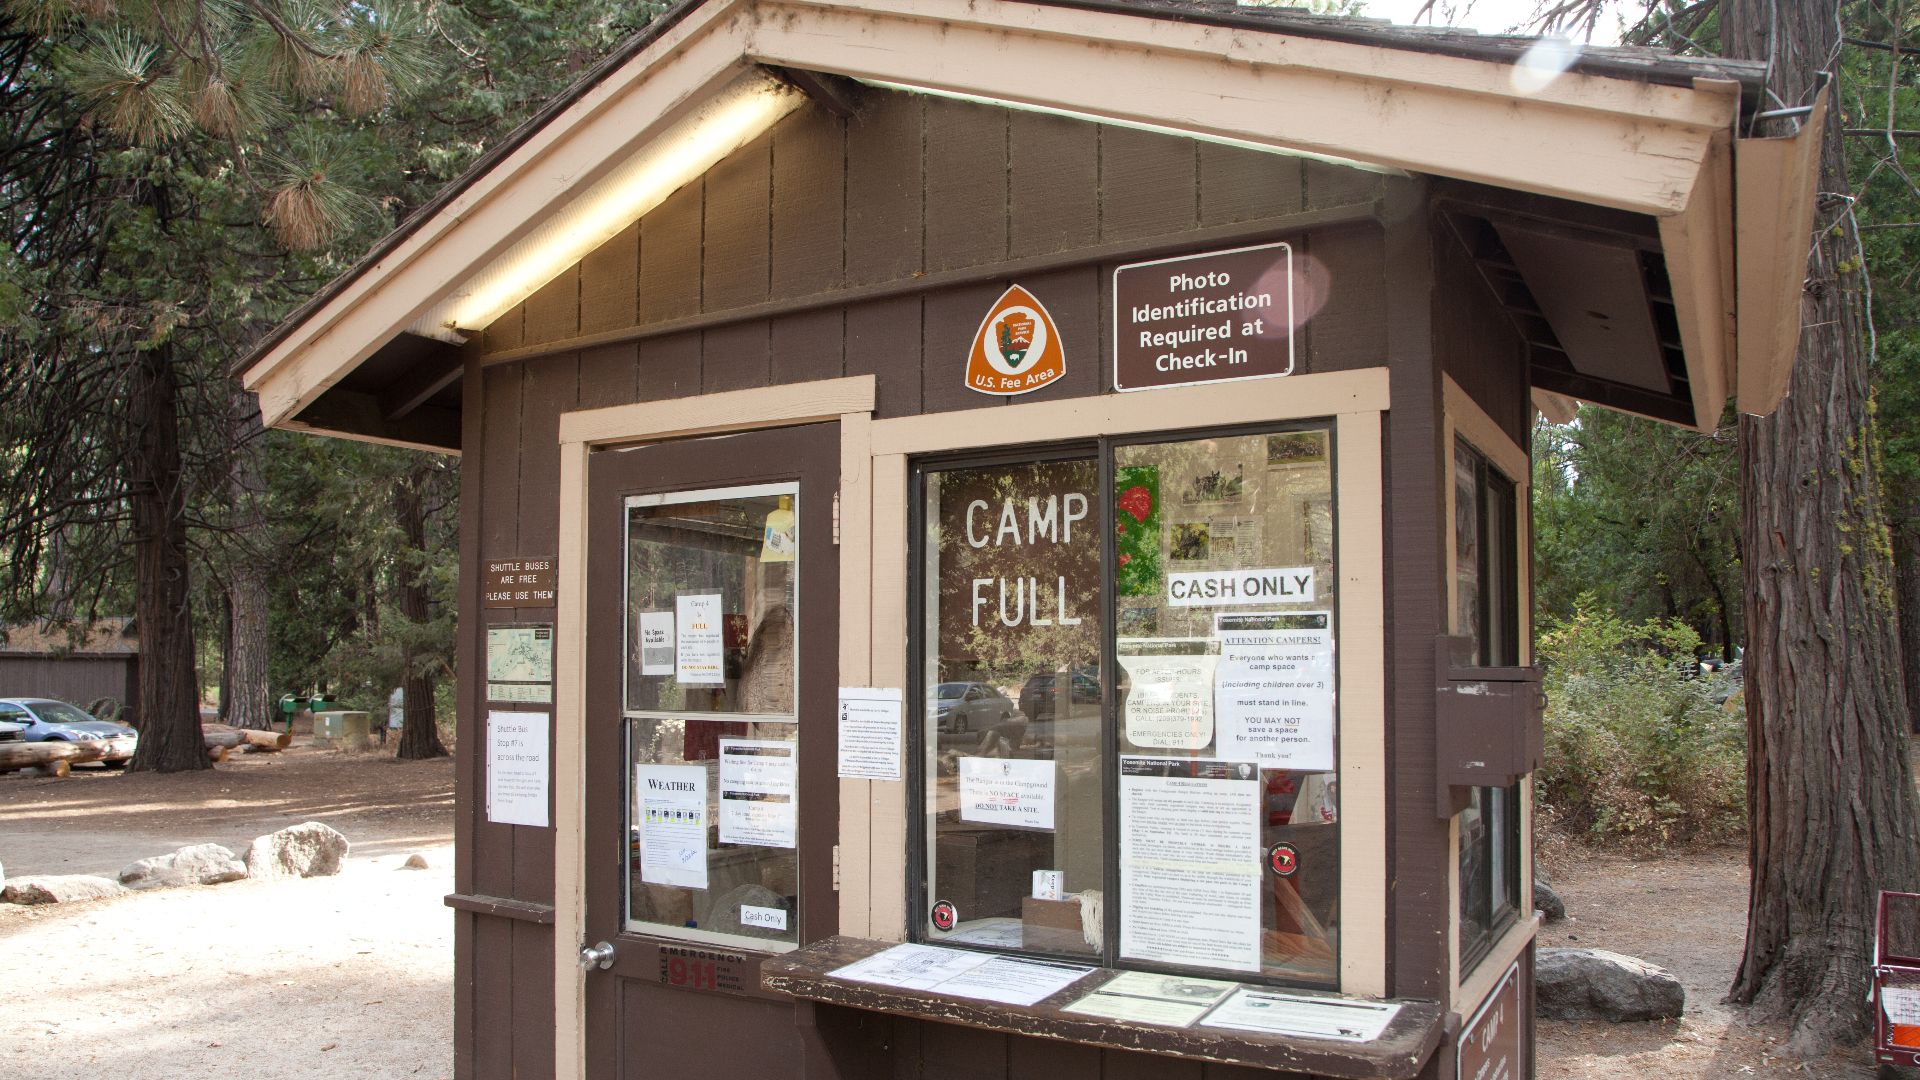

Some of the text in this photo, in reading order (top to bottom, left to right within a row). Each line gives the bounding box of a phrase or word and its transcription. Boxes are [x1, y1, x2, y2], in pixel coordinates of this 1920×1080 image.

[1170, 271, 1230, 293] Photo
[1132, 292, 1272, 323] Identification
[1140, 318, 1264, 348] Required at
[1155, 347, 1248, 372] Check-In
[975, 368, 1055, 389] U.S. Fee Area
[966, 492, 1088, 548] CAMP
[490, 561, 550, 572] SHUTTLE BUSES
[500, 574, 537, 584] ARE FREE
[1170, 574, 1311, 600] CASH ONLY
[485, 590, 553, 601] PLEASE USE THEM
[972, 576, 1082, 627] FULL
[1225, 636, 1321, 645] ATTENTION CAMPERS!
[1229, 654, 1265, 662] Everyone
[1222, 681, 1261, 689] (including
[1316, 681, 1324, 689] 3)
[1284, 717, 1301, 725] NOT
[497, 725, 517, 733] Shuttle
[497, 739, 509, 748] Stop
[526, 754, 540, 762] road
[1277, 752, 1292, 760] you!
[647, 778, 696, 792] WEATHER
[1000, 790, 1020, 799] SPACE
[1000, 804, 1017, 812] TAKE
[744, 910, 782, 925] Cash Only
[660, 946, 743, 964] EMERGENCY
